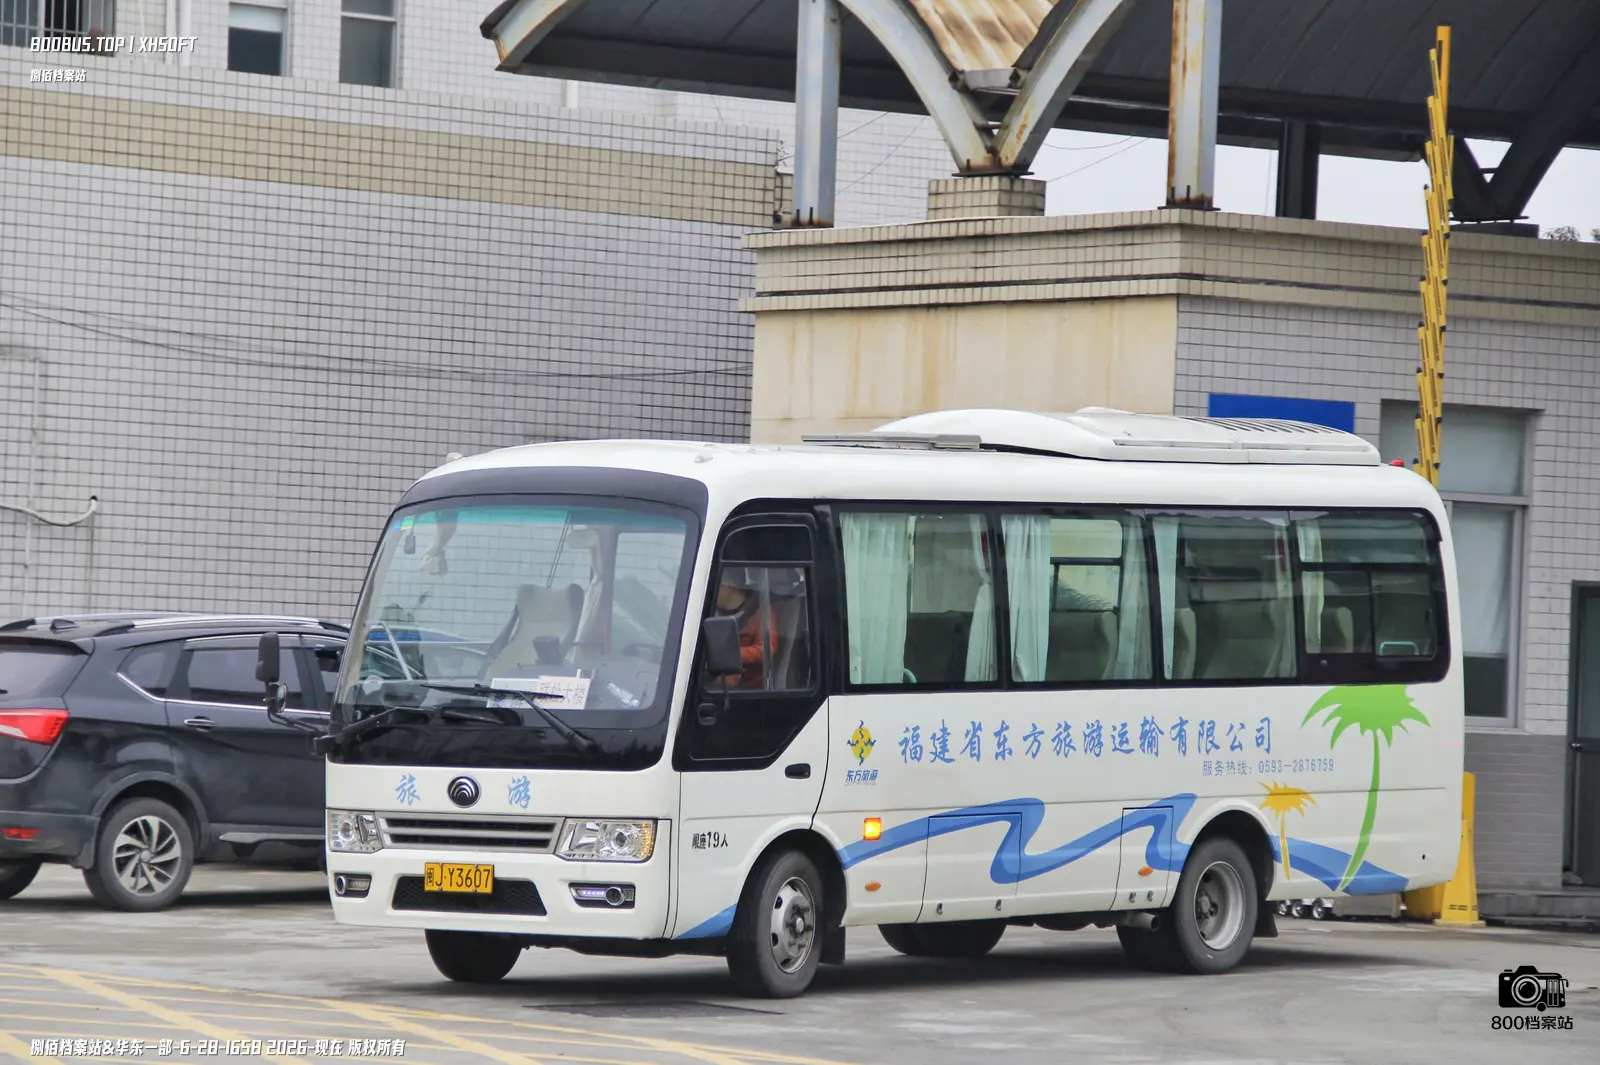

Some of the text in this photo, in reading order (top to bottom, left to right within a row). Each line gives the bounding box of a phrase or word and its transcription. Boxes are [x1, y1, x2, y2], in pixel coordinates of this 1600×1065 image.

[898, 715, 1272, 764] 福建省东方旅游运输有限公司
